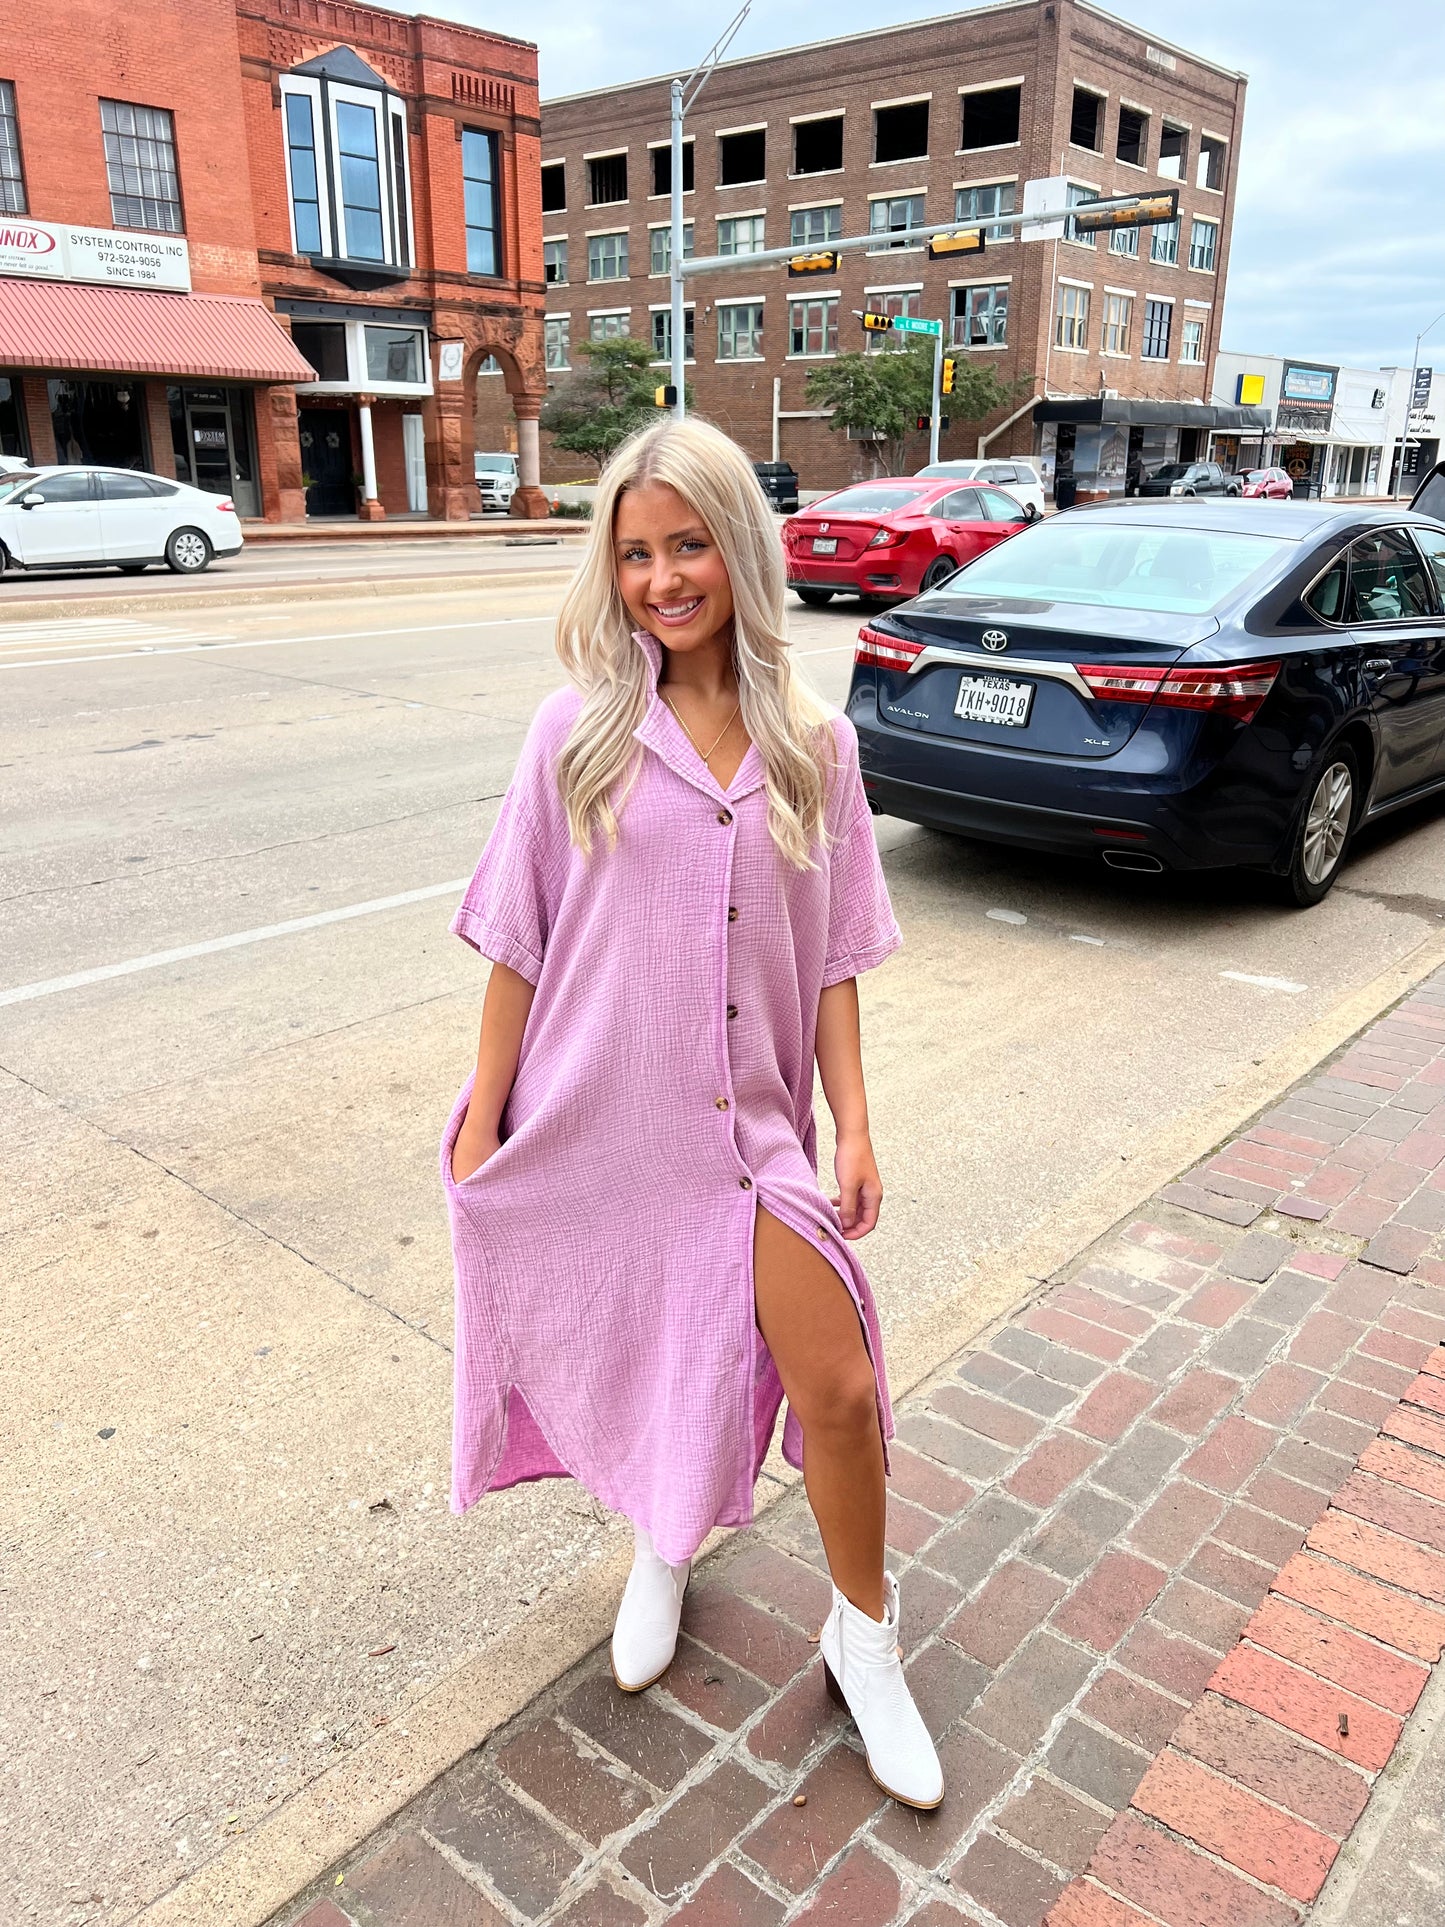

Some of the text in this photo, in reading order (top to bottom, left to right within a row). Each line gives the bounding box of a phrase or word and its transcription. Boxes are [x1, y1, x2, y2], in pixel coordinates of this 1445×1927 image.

[71, 235, 183, 257] SYSTEM CONTROL INC
[97, 252, 161, 267] 972-524-9056
[106, 266, 156, 279] SINCE 1984
[983, 680, 1010, 691] TEXAS
[887, 705, 929, 719] AVALON
[1083, 738, 1110, 746] XLE
